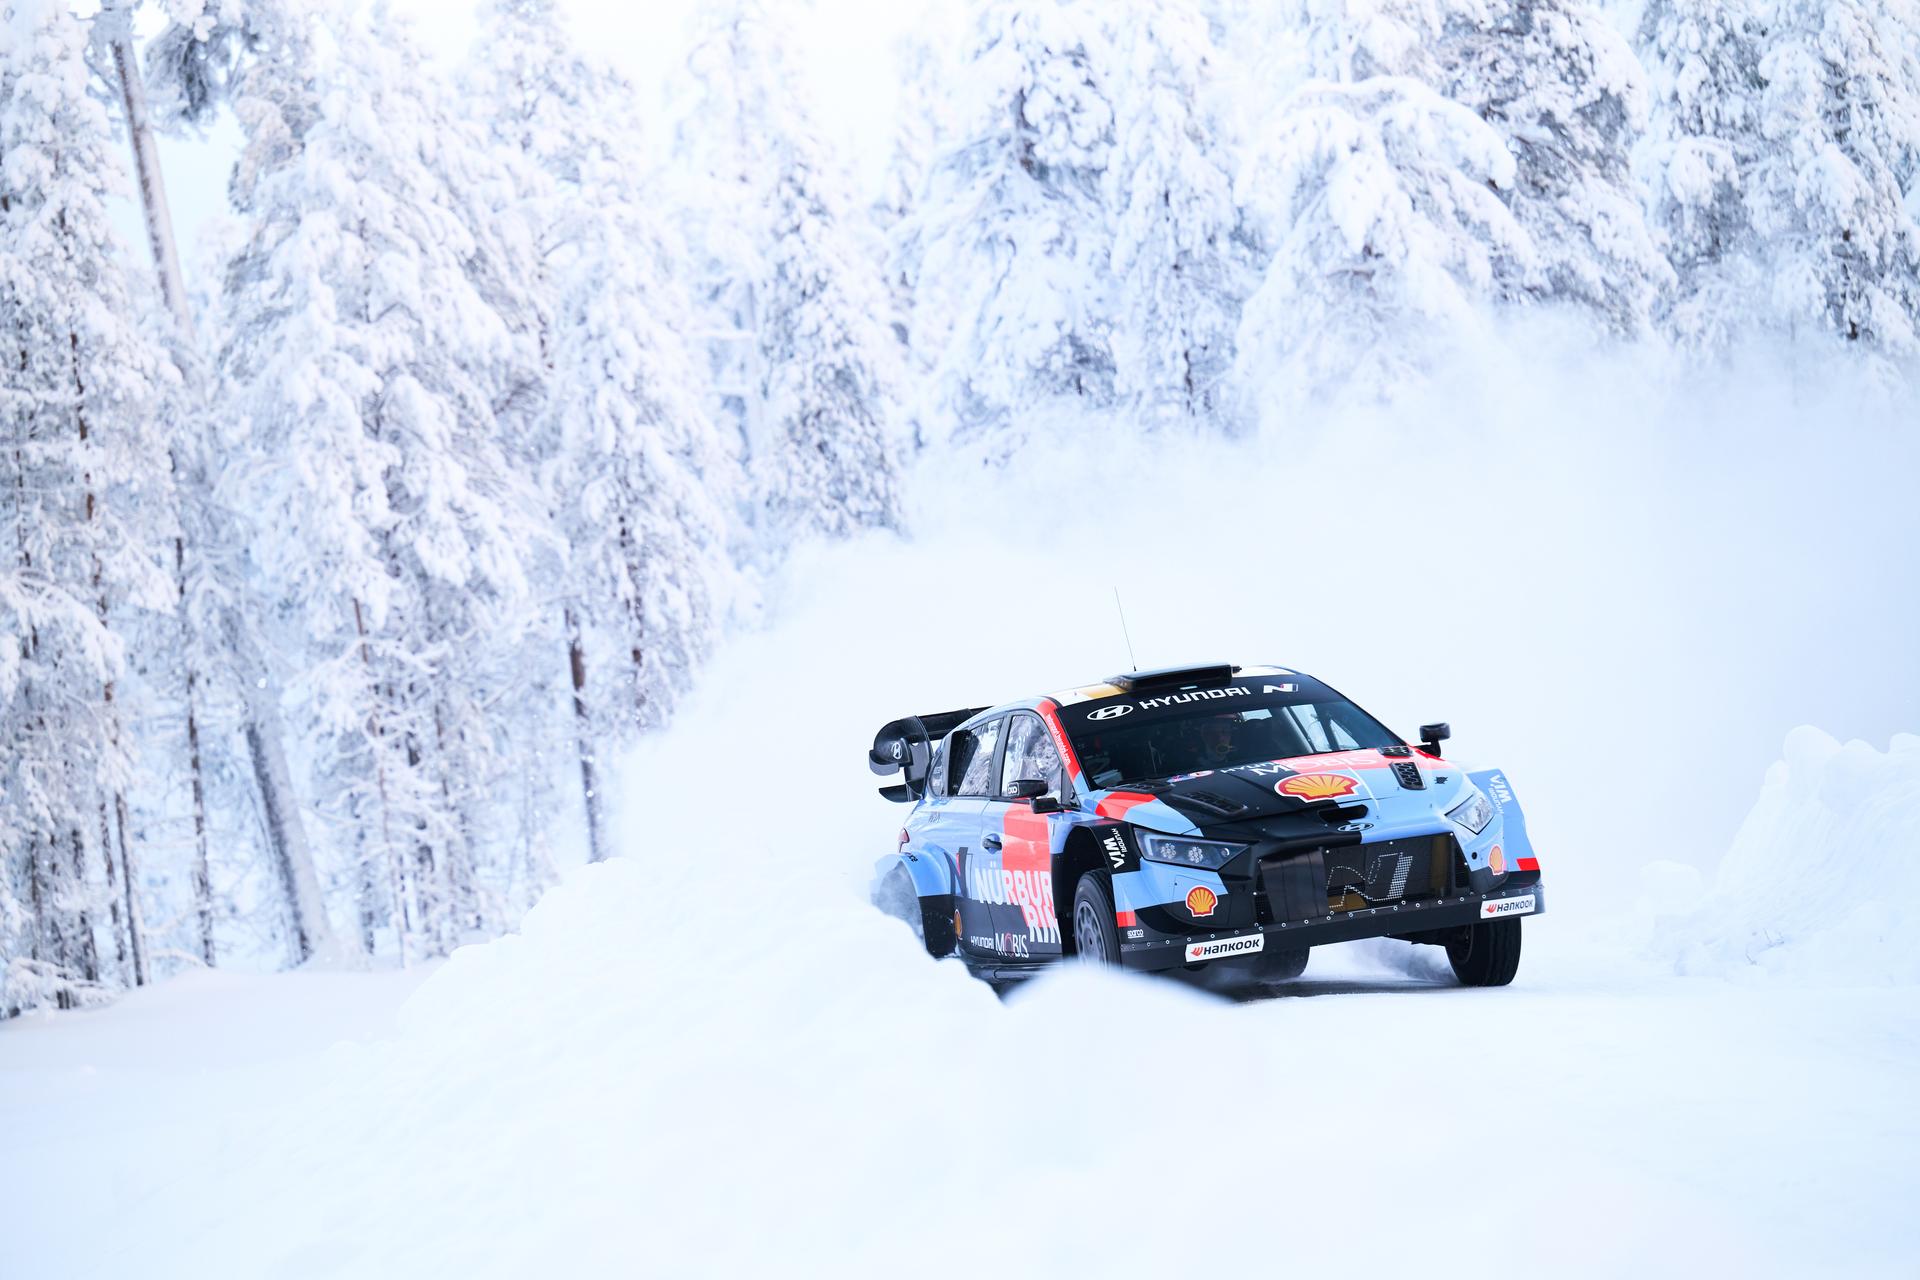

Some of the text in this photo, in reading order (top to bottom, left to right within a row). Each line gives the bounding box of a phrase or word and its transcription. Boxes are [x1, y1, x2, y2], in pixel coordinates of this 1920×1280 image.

[1139, 686, 1252, 710] HYUNDAI
[1103, 837, 1125, 869] WIA
[1110, 827, 1128, 853] HYUNDAI
[970, 932, 1030, 959] HYUNDAI MOBIS
